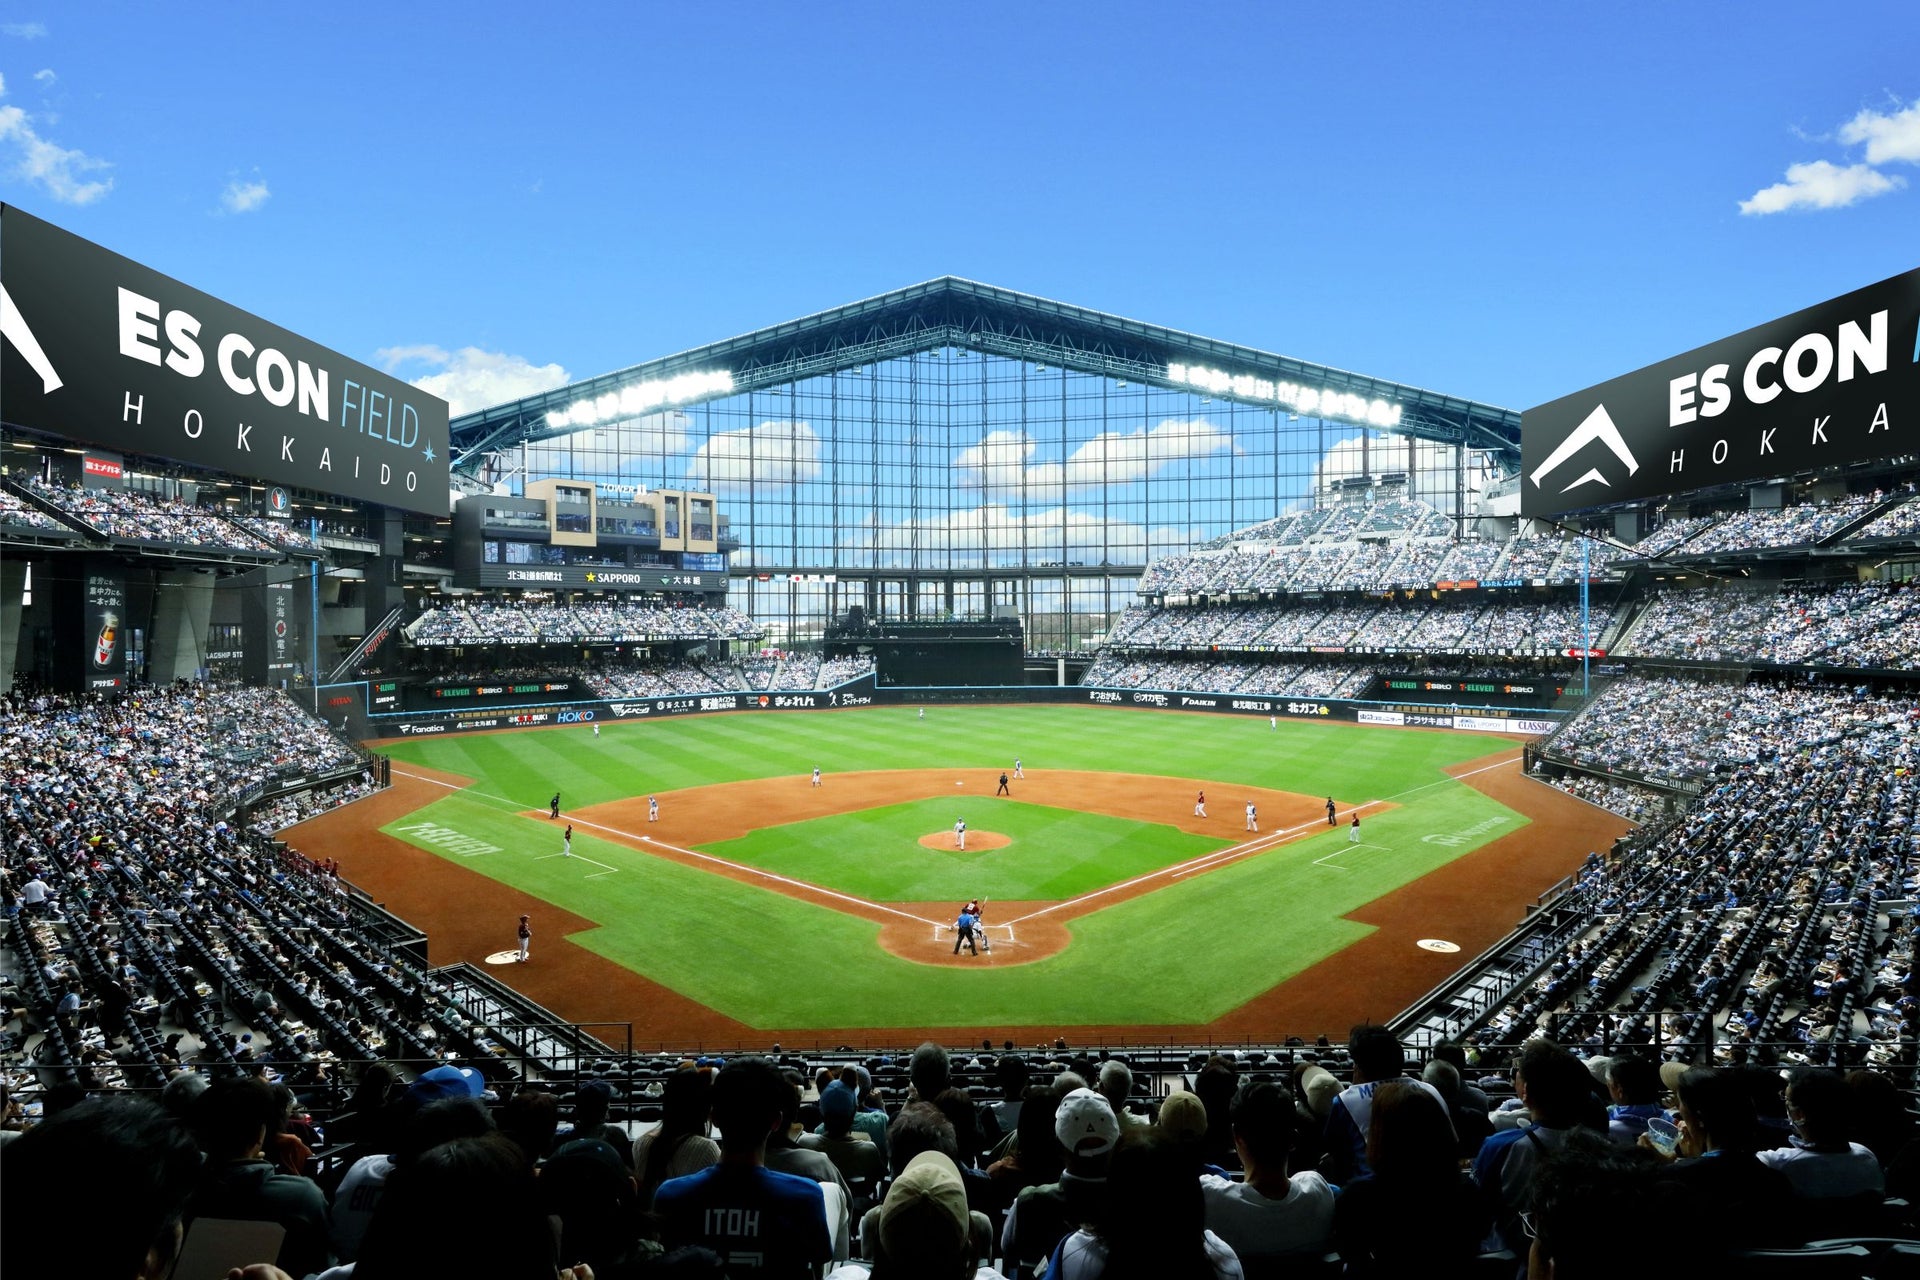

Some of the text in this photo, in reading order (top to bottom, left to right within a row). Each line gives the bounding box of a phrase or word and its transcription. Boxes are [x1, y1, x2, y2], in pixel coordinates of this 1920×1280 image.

[118, 286, 419, 449] ES CON FIELD
[1669, 364, 1732, 428] ES
[1743, 309, 1888, 405] CON
[123, 391, 417, 492] HOKKAIDO
[1669, 402, 1890, 474] HOKKA
[601, 482, 635, 494] TOWER
[507, 571, 563, 582] 北海道新聞社
[597, 573, 641, 584] SAPPORO
[673, 575, 701, 585] 大林組
[364, 627, 389, 657] FUJITEC
[501, 636, 538, 644] TOPPAN
[545, 635, 572, 643] nepia
[508, 685, 539, 694] 7-ELEVEN
[1385, 681, 1416, 689] 7-ELEVEN
[1460, 683, 1495, 692] 7-ELEVEN
[436, 688, 470, 697] 7-ELEVEN
[1090, 691, 1122, 701] まつおかまん
[1141, 693, 1168, 703] オカモト
[775, 695, 815, 707] ぎょれん
[1287, 702, 1319, 715] 北ガス
[514, 714, 548, 722] KOTOBUKI
[557, 710, 594, 723] HOKKO
[1405, 715, 1453, 727] ナラサキ産業
[412, 724, 445, 734] Fanatics
[1518, 721, 1551, 732] CLASSIC
[282, 778, 306, 788] Panasonic
[1643, 775, 1668, 786] docomo
[704, 1207, 760, 1237] ITOH
